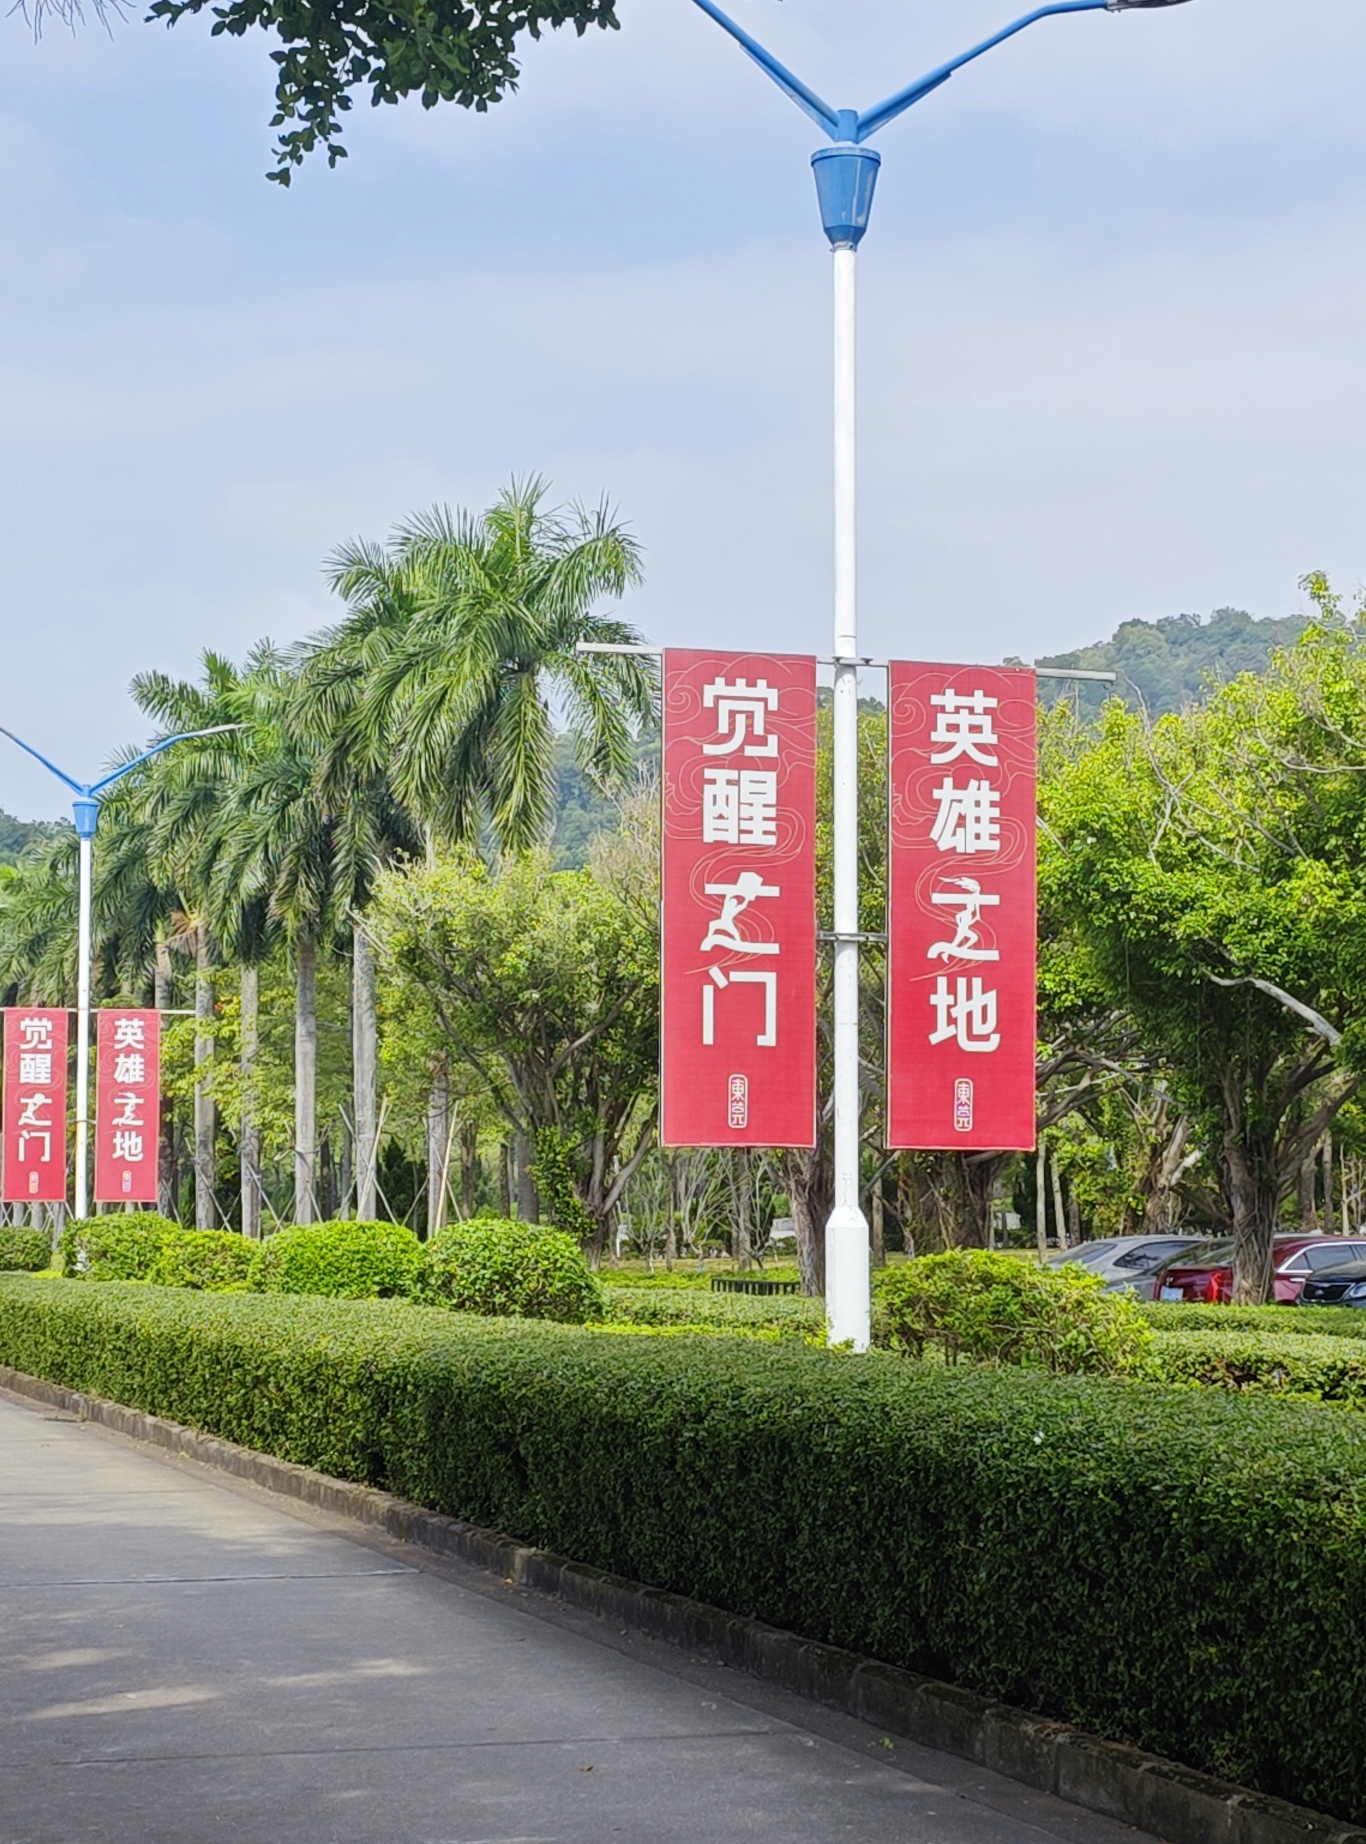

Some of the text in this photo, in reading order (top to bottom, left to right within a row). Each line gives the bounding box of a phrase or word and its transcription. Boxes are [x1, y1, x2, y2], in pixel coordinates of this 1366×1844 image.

[700, 676, 781, 1047] 觉醒之门
[927, 688, 1002, 1053] 英雄之地
[18, 1017, 53, 1163] 觉醒之门
[111, 1018, 145, 1162] 英雄之地
